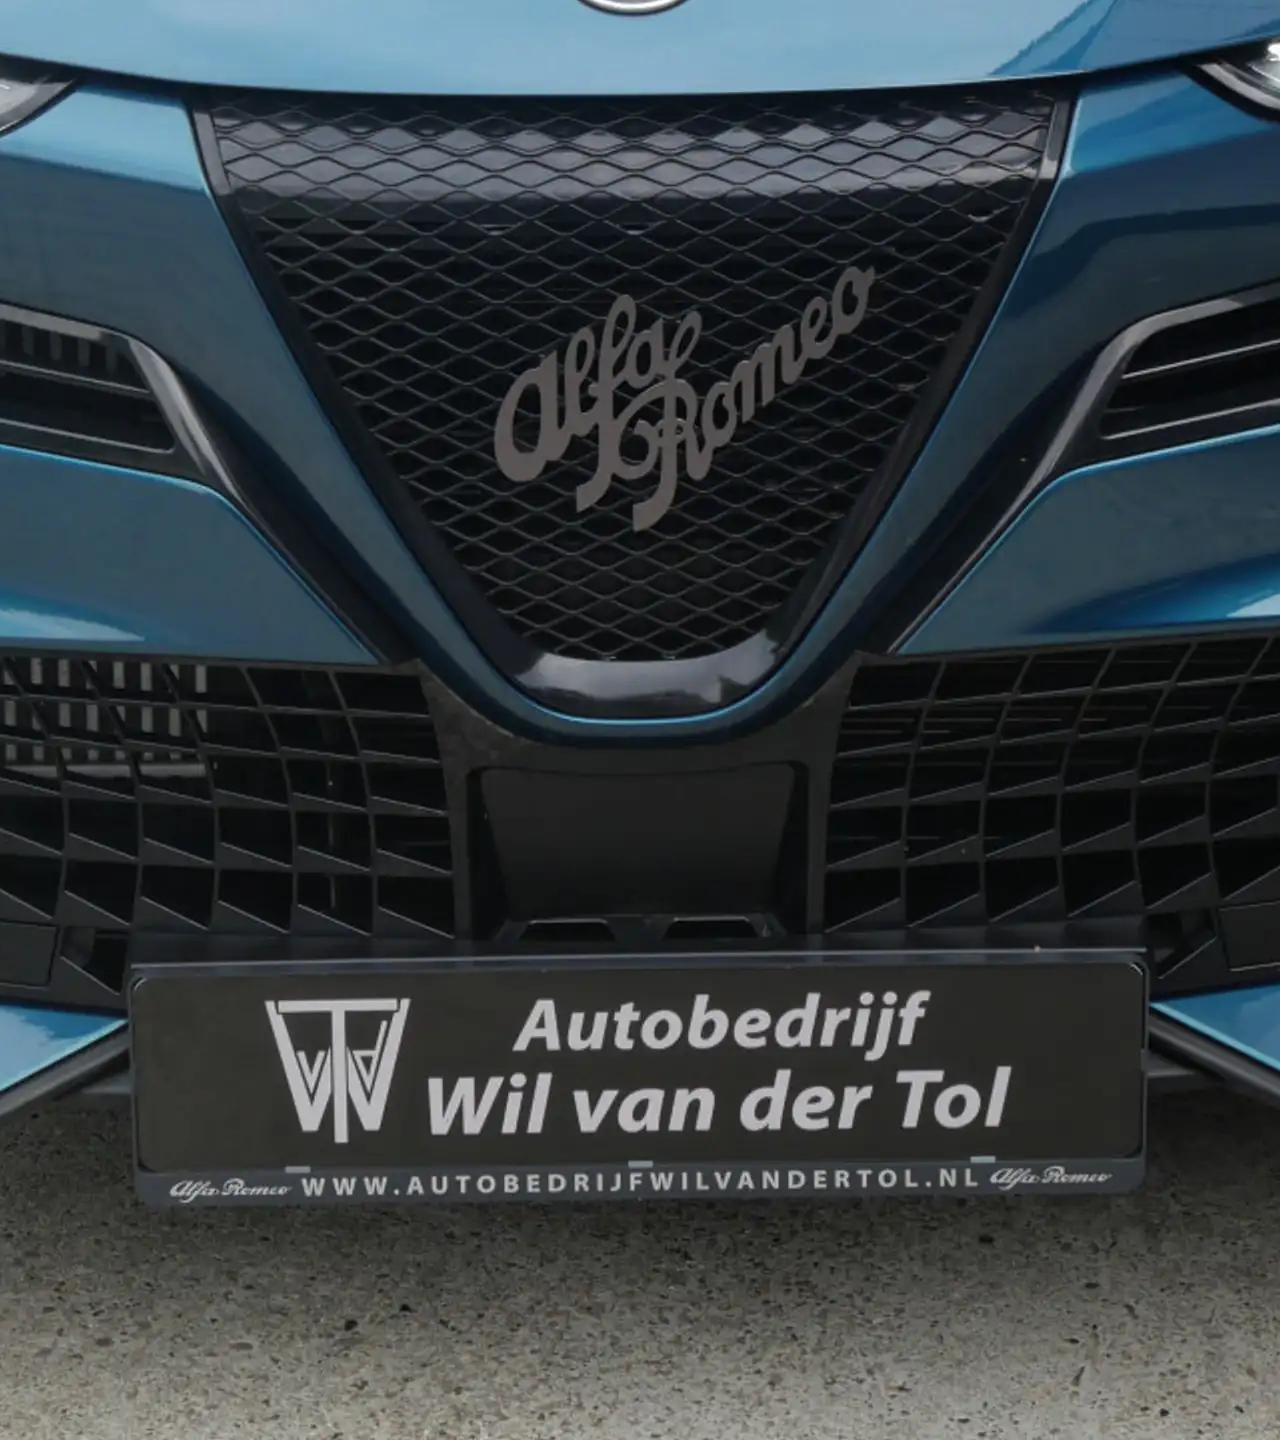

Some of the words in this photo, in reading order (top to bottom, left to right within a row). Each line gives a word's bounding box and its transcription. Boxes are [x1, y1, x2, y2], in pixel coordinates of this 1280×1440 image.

[512, 990, 933, 1063] Autobedrijf
[427, 1072, 553, 1137] Wil
[573, 1087, 715, 1133] van
[739, 1068, 874, 1132] der
[896, 1065, 1012, 1129] Tol
[221, 1177, 292, 1197] Romeo
[301, 1167, 978, 1197] WWW.AUTOBEDRIJFWILVANDERTOL.NL
[1041, 1164, 1112, 1185] Romeo
